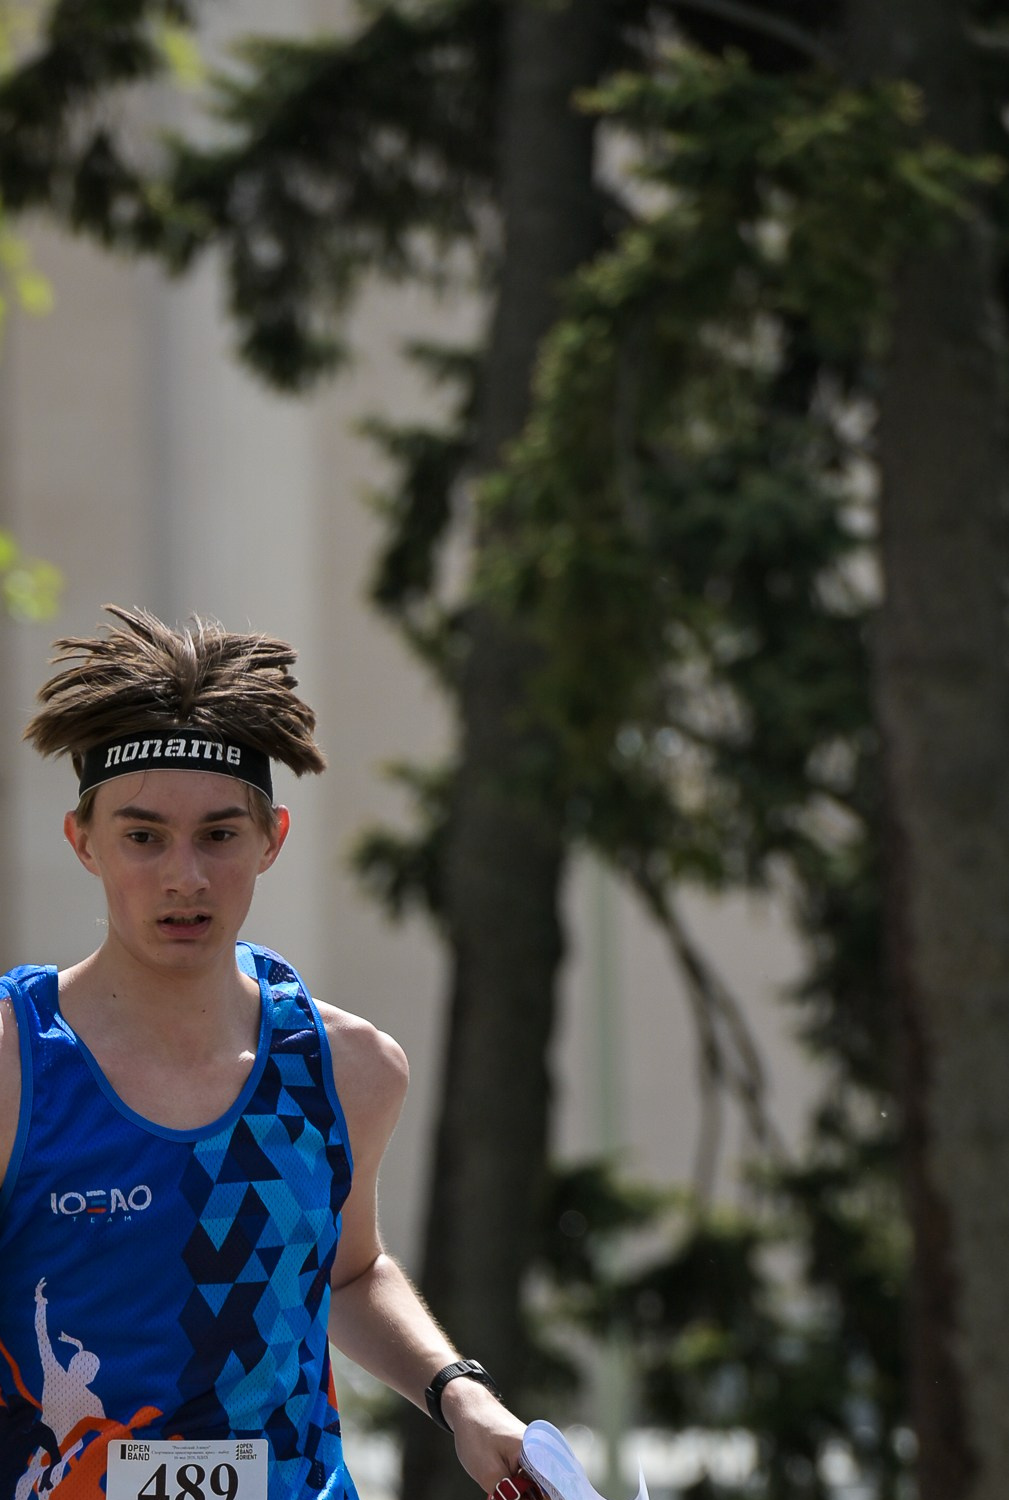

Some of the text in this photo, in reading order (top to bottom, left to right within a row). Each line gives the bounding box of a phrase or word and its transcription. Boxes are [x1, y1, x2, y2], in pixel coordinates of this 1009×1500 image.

[105, 738, 241, 768] noname
[72, 1215, 132, 1224] TEAM
[127, 1444, 150, 1452] OPEN
[127, 1452, 150, 1461] BAND
